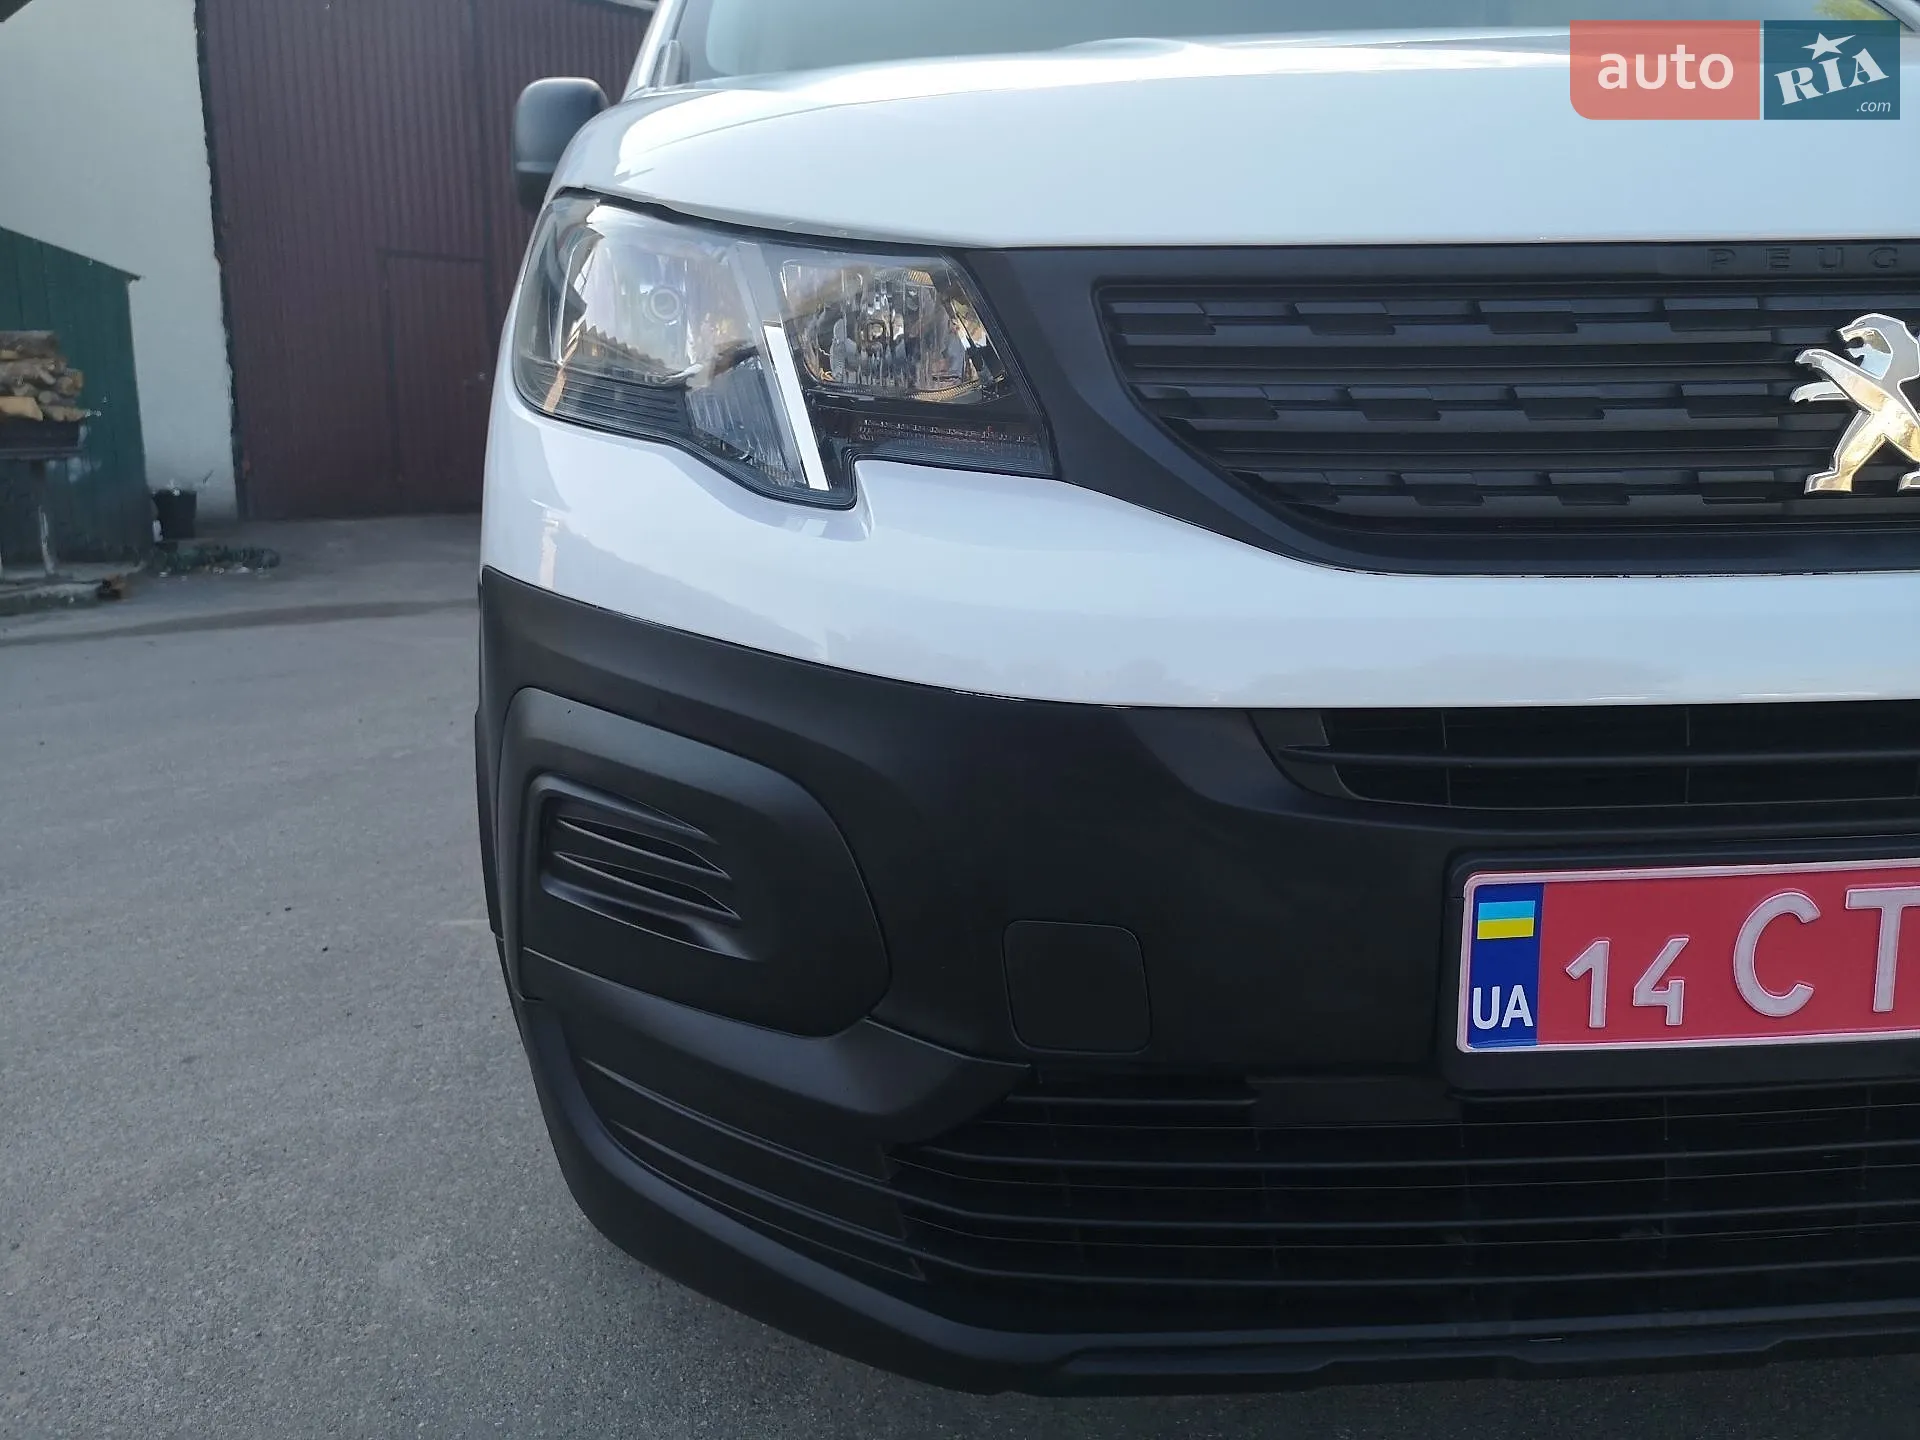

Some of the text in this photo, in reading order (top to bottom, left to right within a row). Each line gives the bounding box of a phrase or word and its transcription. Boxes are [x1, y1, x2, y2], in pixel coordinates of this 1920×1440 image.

[1705, 246, 1899, 270] PEUG
[1564, 886, 1920, 1028] 14 CT
[1471, 984, 1534, 1030] UA
